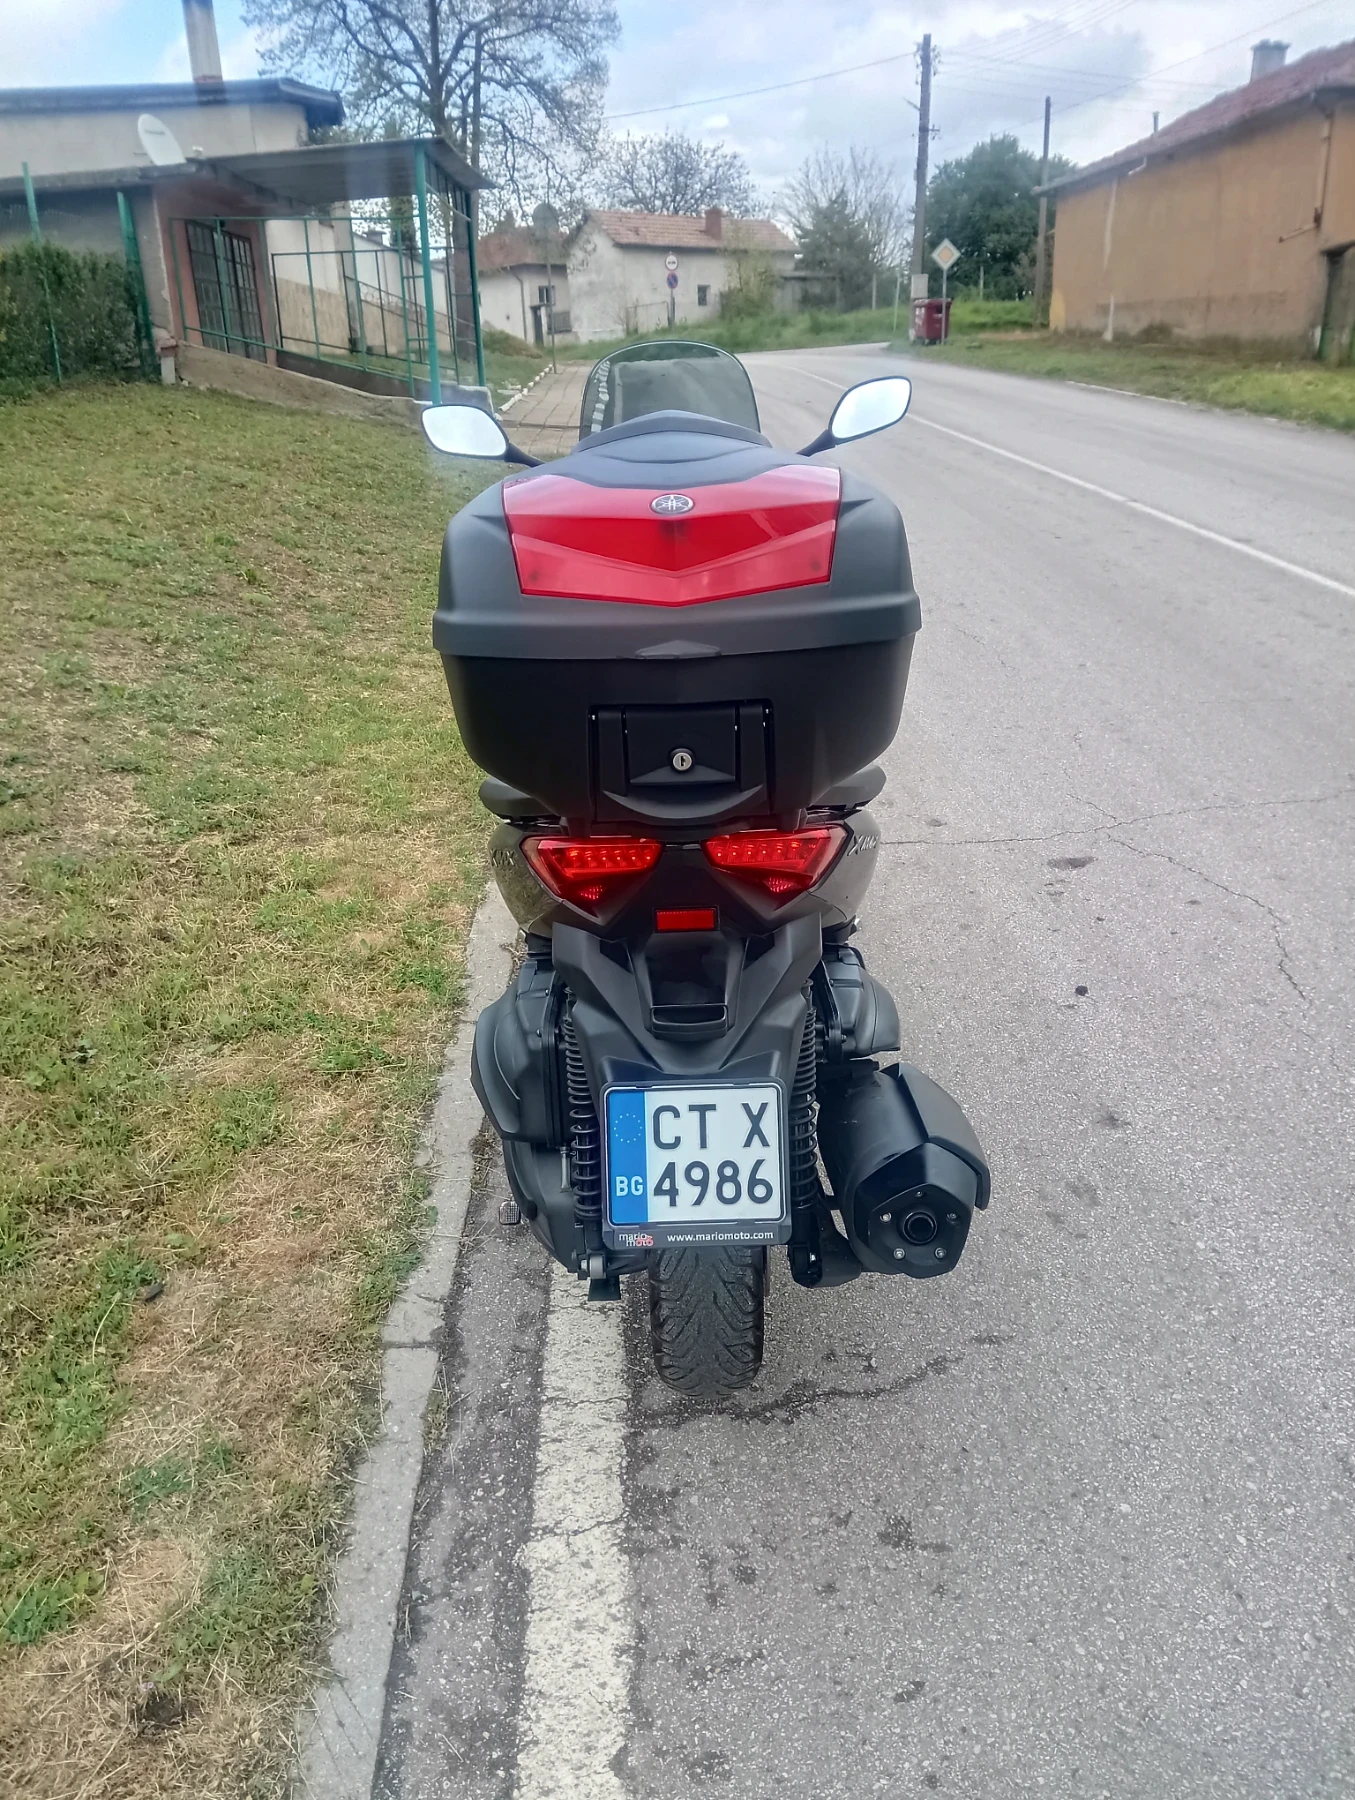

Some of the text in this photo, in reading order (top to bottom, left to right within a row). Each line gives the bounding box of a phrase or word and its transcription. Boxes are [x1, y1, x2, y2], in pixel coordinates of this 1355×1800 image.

[652, 1102, 770, 1150] CT X
[615, 1175, 644, 1197] BG
[653, 1158, 774, 1207] 4986
[666, 1231, 774, 1242] www.mariomoto.com
